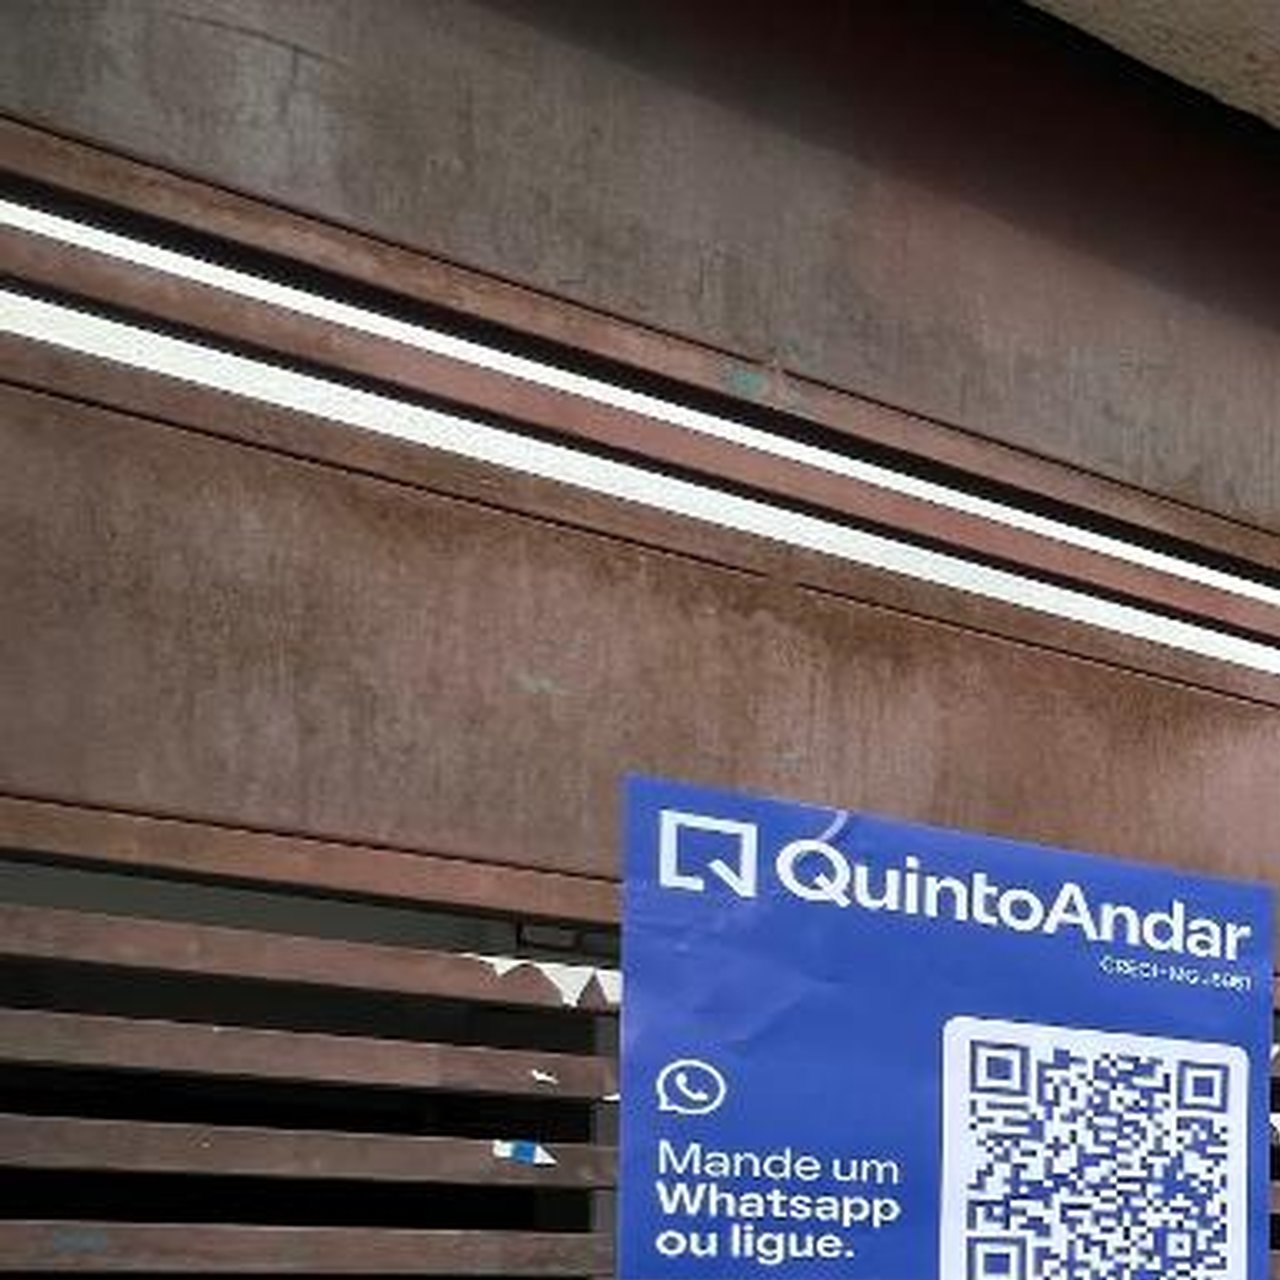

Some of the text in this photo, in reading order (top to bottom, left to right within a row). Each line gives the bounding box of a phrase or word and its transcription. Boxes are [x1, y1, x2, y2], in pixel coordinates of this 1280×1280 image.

[776, 839, 1251, 960] QuintoAndar
[658, 1139, 899, 1185] Mande um
[655, 1179, 901, 1228] Whatsapp
[655, 1223, 856, 1266] ou ligue.
